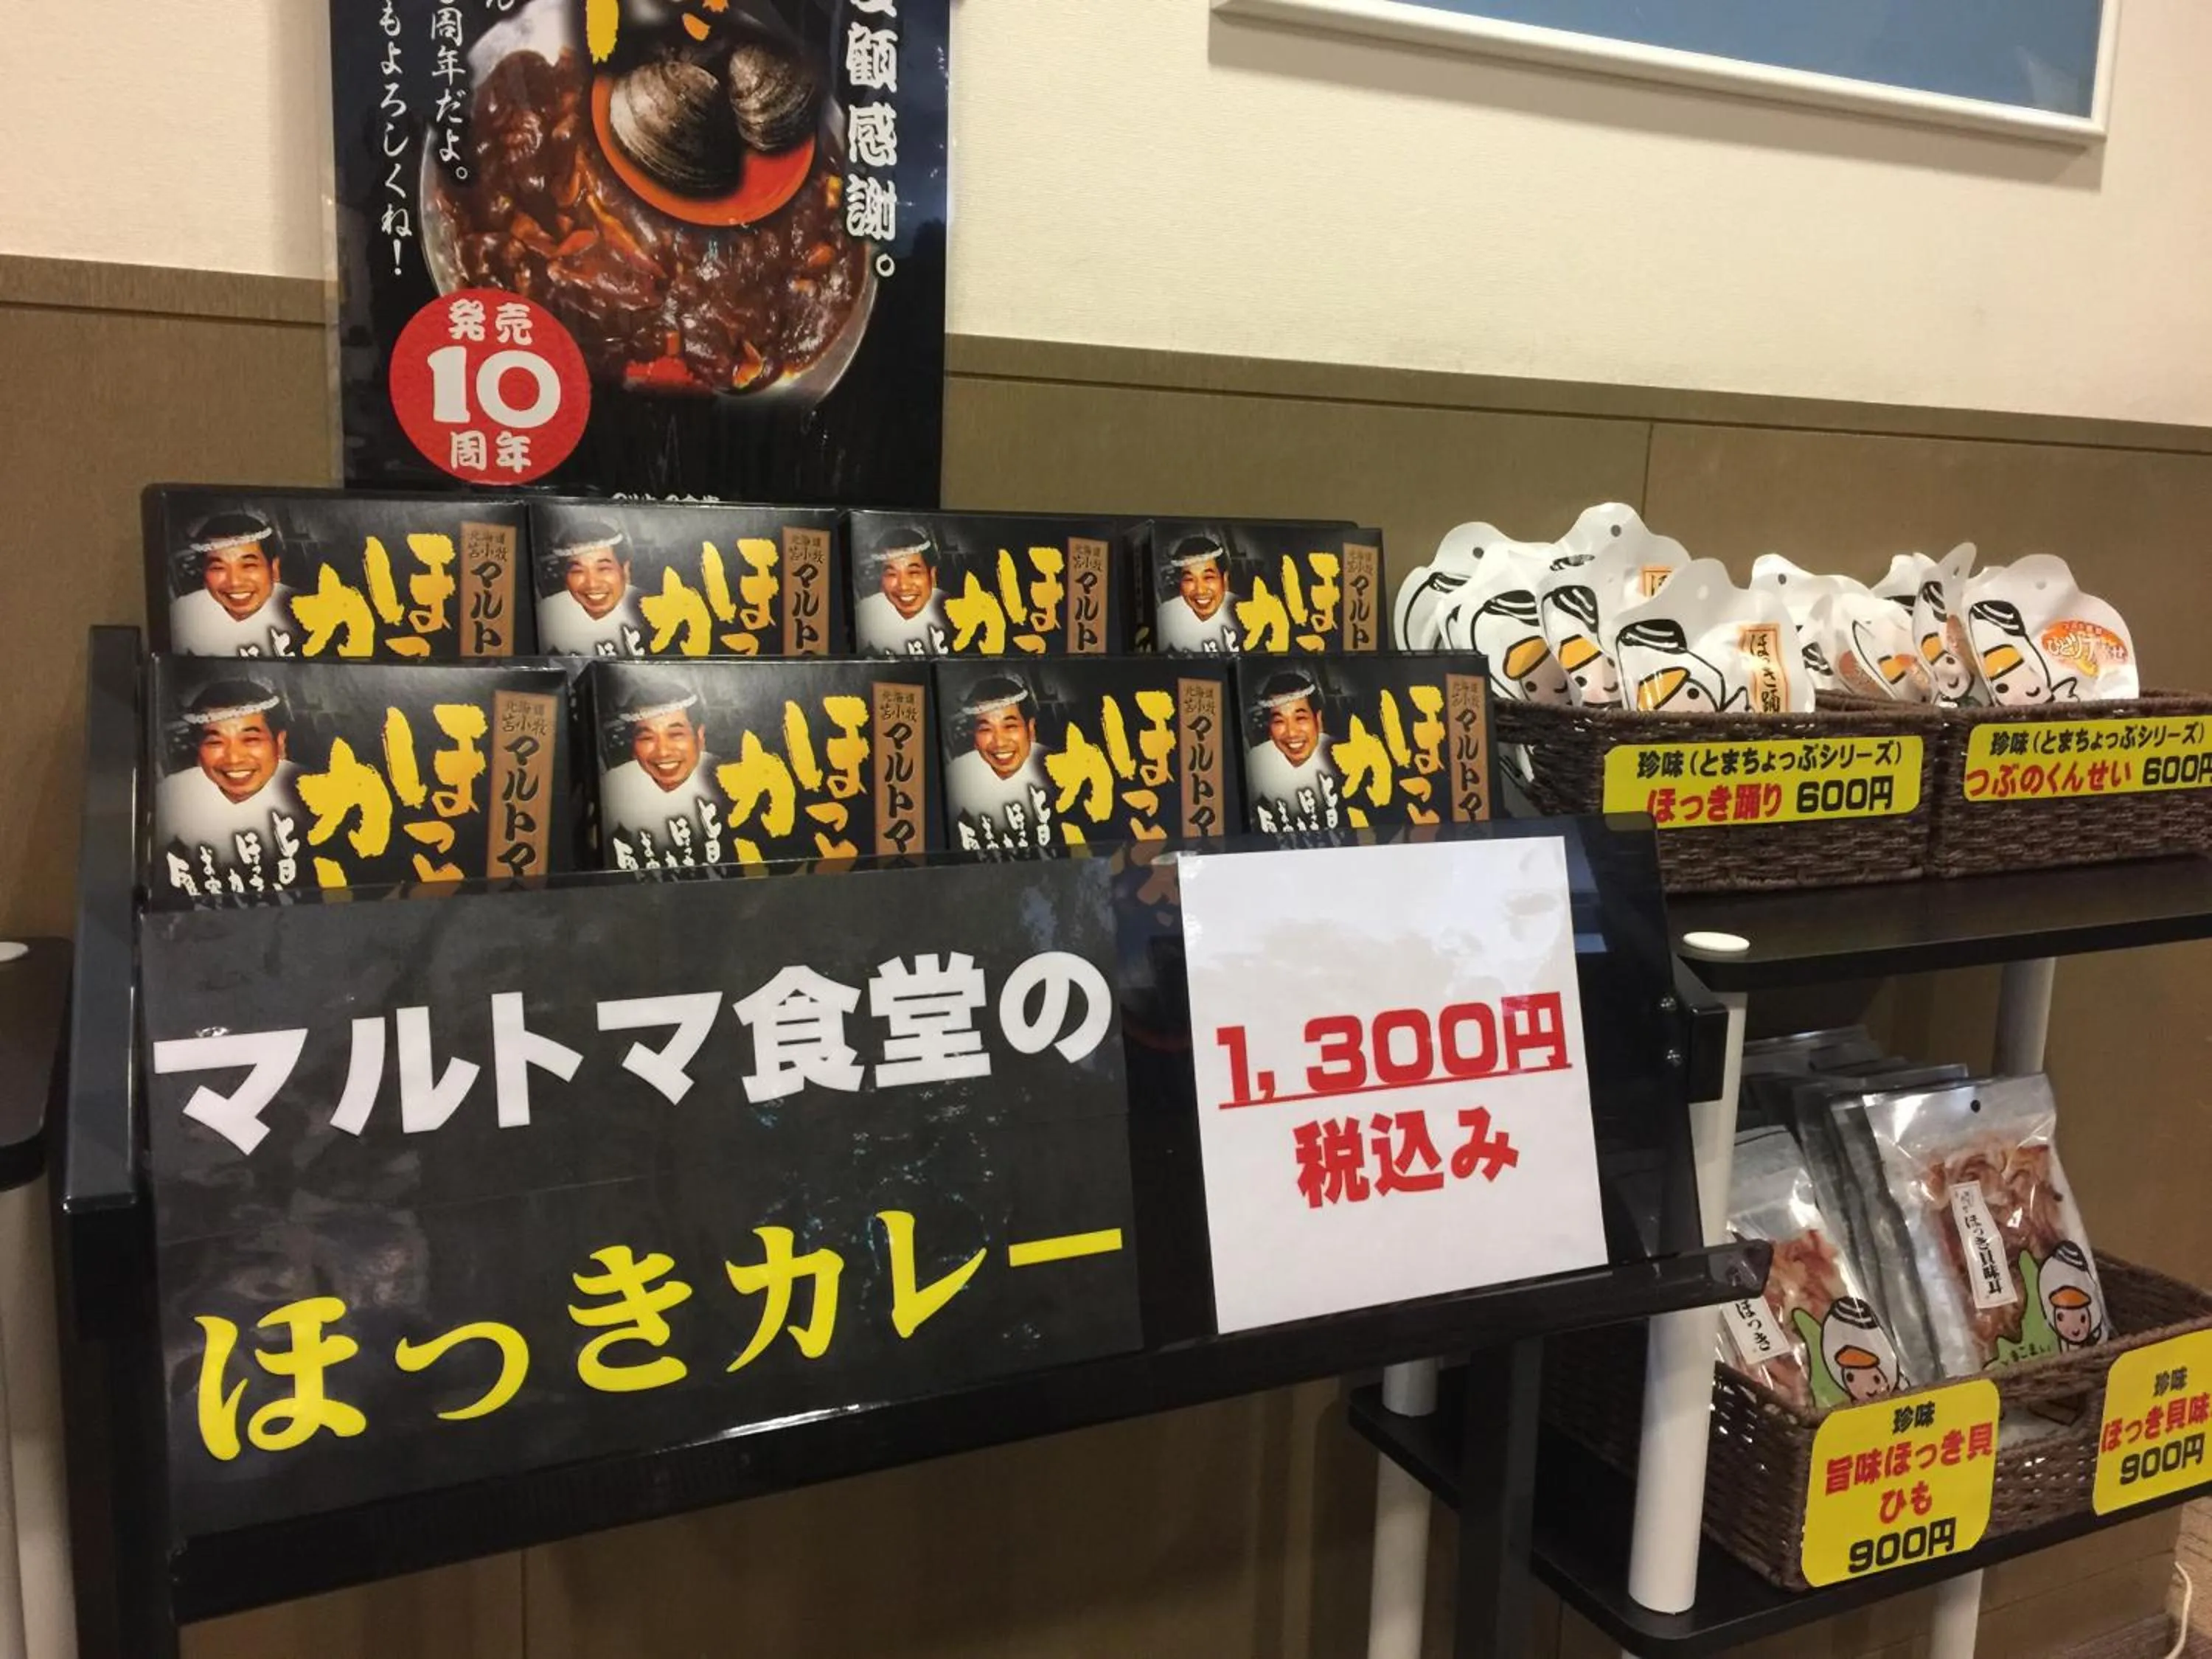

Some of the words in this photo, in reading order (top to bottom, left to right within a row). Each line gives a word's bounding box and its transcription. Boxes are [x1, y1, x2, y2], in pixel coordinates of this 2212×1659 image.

[431, 0, 469, 179] 周年だよ。
[846, 0, 898, 276] 顧感謝。
[448, 298, 533, 346] 発売
[427, 345, 561, 428] 10
[450, 430, 532, 473] 周年
[792, 563, 819, 655] マルト
[1635, 740, 1902, 779] 珍味（とまちょっぷシリーズ）
[1966, 760, 2132, 798] つぶのくんせい
[1646, 782, 1783, 824] ほっき踊り
[1796, 775, 1894, 813] 600円
[154, 951, 1113, 1156] マルトマ食堂の
[1217, 992, 1569, 1105] 1,300円
[1293, 1106, 1519, 1209] 税込み
[194, 1210, 1123, 1461] ほっきカレー
[1892, 1400, 1935, 1435] 珍味
[2101, 1392, 2212, 1453] ほっき貝味
[1825, 1422, 1993, 1497] 旨味ほっき貝
[2120, 1432, 2206, 1485] 900円
[1879, 1481, 1933, 1524] ひも
[1848, 1517, 1956, 1573] 900円
